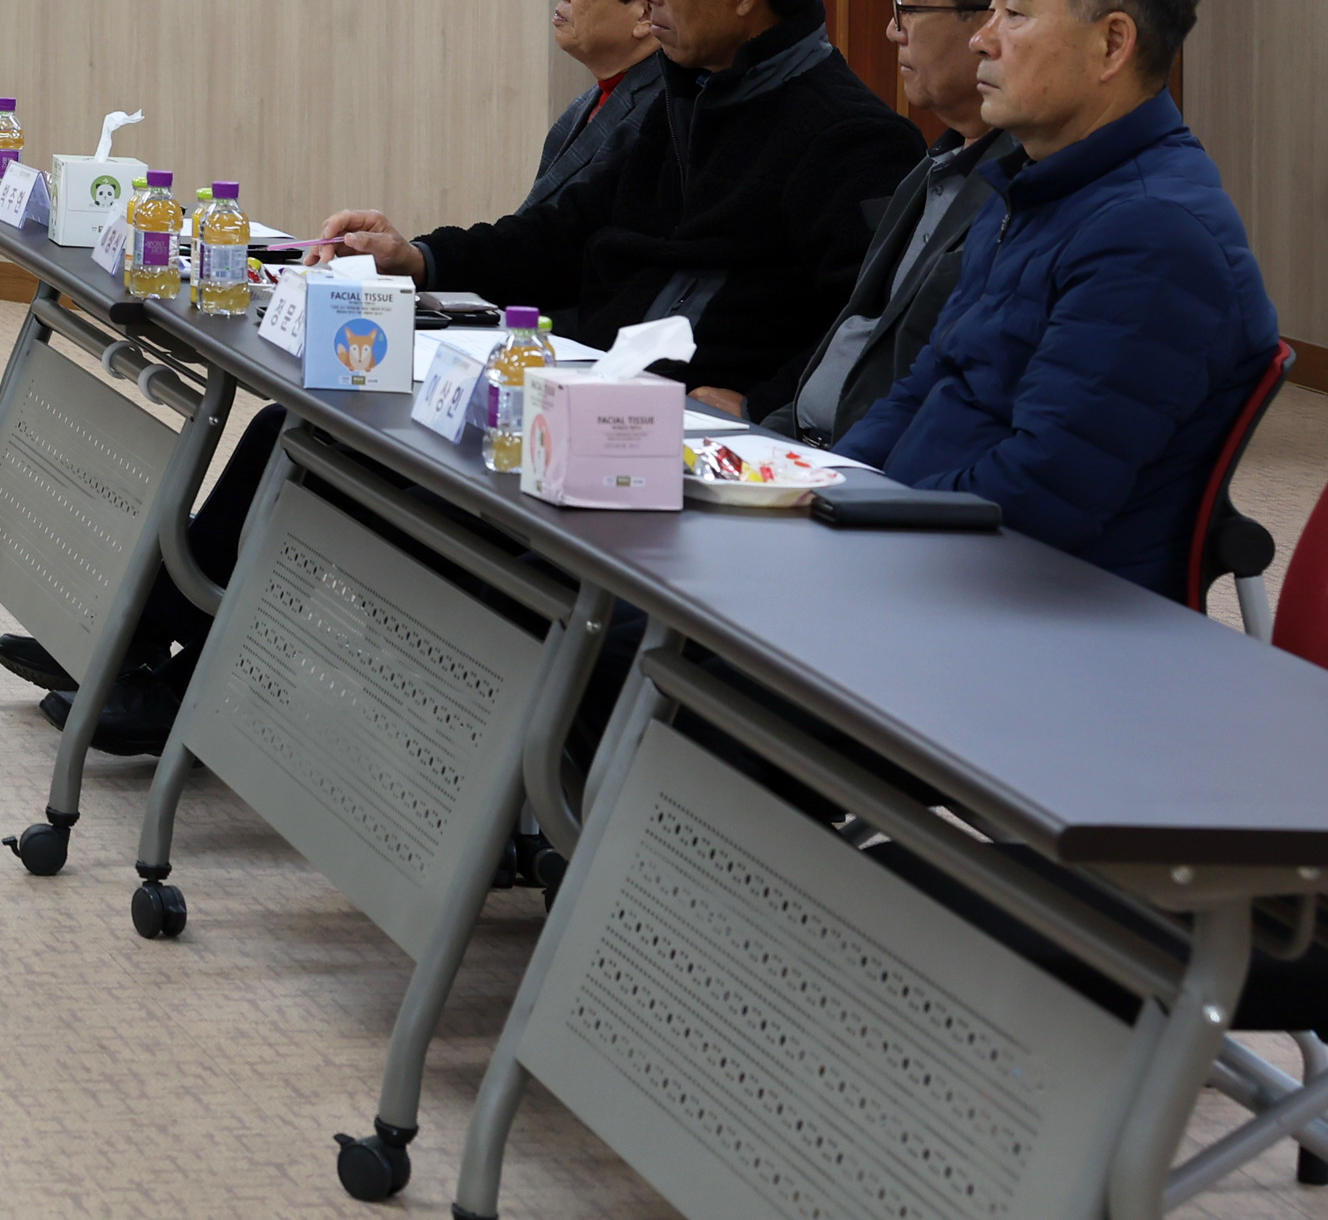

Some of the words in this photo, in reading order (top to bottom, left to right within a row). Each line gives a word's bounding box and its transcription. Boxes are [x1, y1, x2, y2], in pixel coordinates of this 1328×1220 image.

[330, 291, 361, 301] FACIAL
[363, 292, 394, 303] TISSUE
[597, 416, 625, 425] FACIAL
[628, 416, 655, 425] TISSUE
